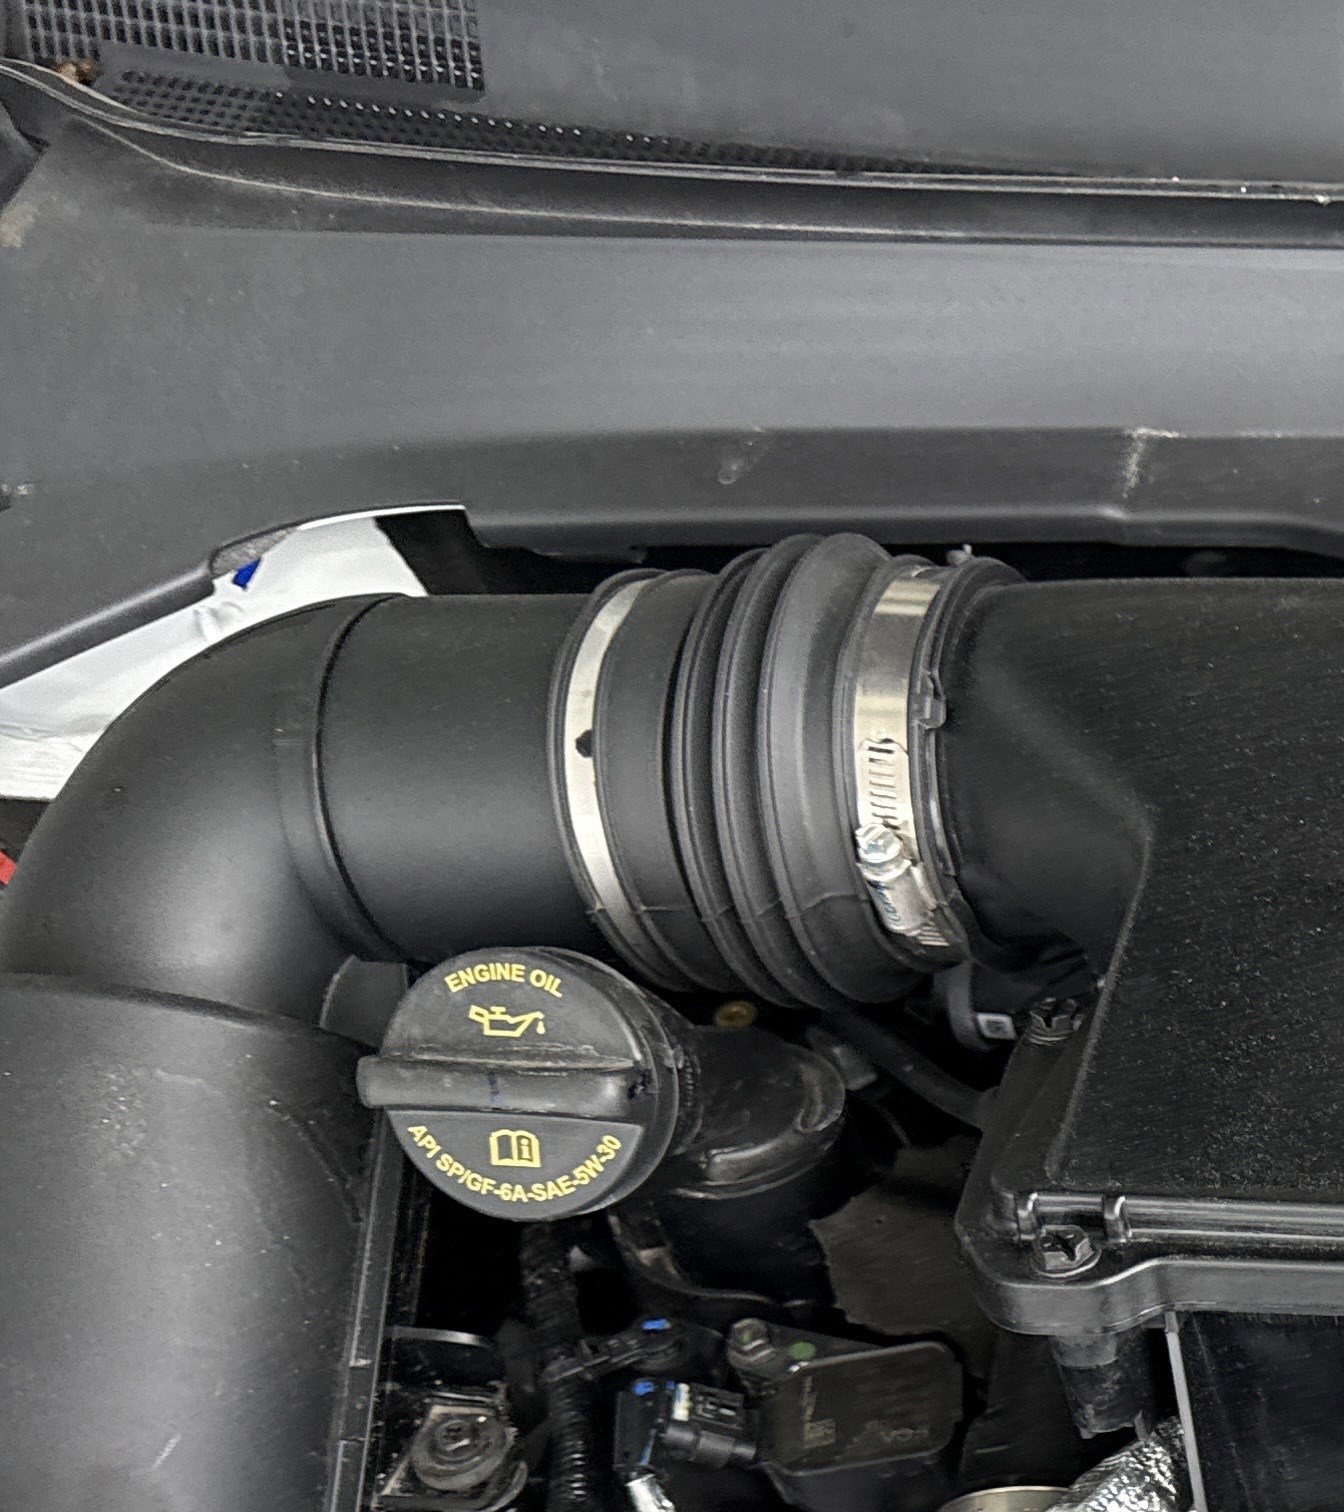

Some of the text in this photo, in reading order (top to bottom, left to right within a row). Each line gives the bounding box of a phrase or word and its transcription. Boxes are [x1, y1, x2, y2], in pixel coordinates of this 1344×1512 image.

[445, 962, 563, 998] ENGINE OIL
[408, 1125, 440, 1158] API
